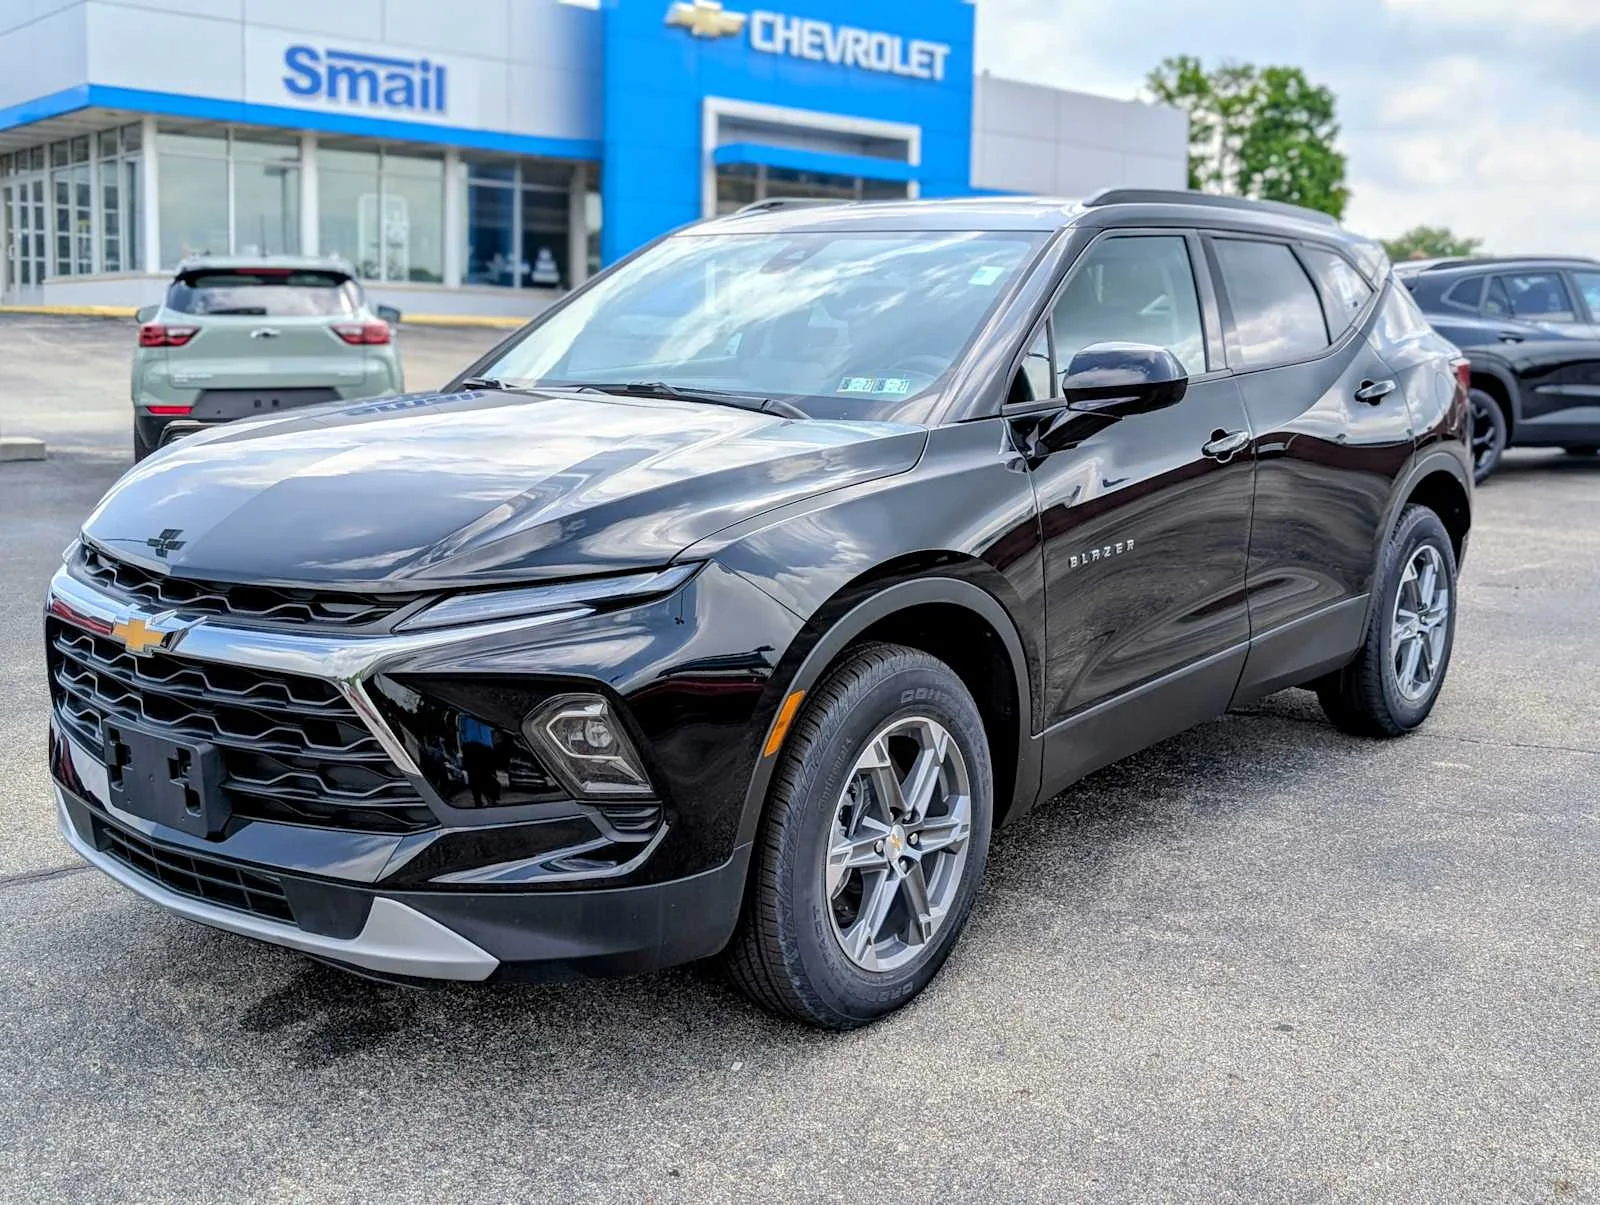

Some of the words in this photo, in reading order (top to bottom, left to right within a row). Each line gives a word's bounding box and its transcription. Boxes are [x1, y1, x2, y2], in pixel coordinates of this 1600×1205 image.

[283, 45, 447, 111] Smail
[751, 10, 951, 81] CHEVROLET
[1069, 539, 1135, 568] BLAZER
